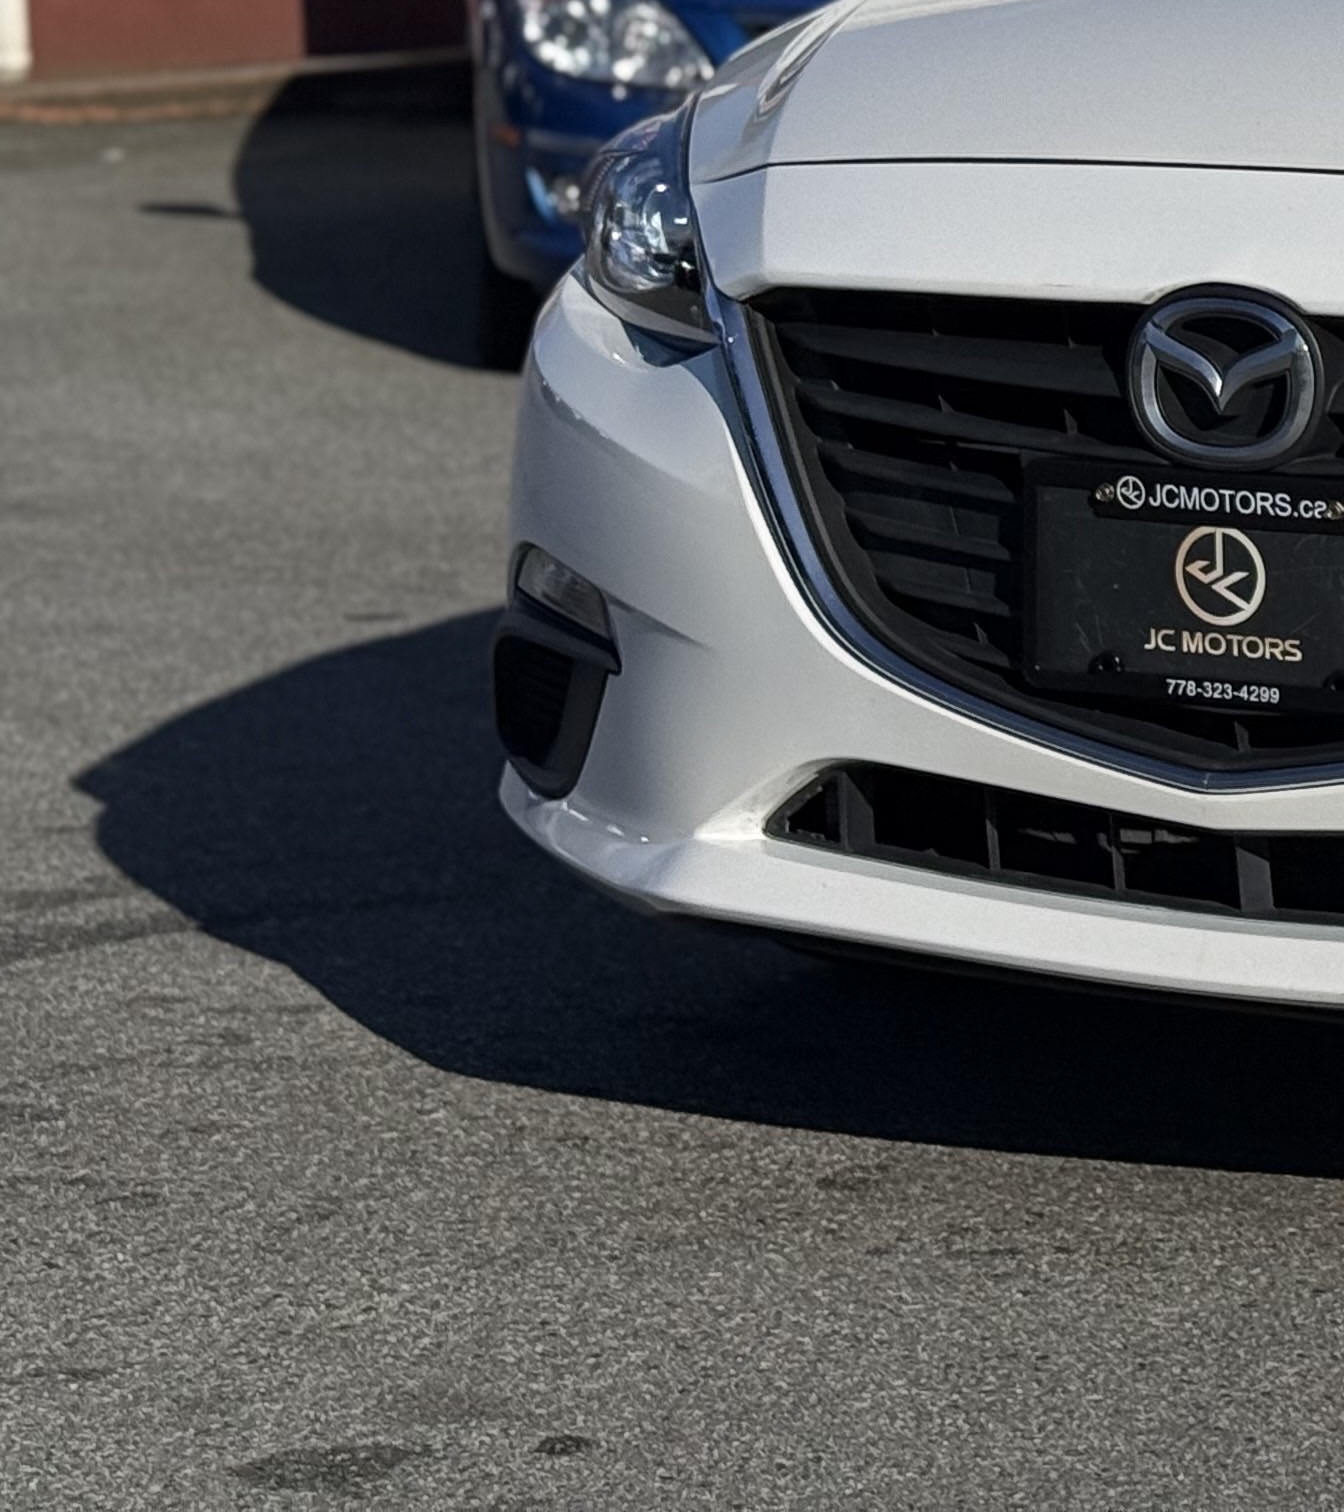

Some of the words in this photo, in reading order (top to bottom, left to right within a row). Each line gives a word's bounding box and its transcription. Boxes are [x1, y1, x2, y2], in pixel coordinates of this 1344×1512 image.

[1143, 628, 1176, 652] JC
[1182, 631, 1303, 662] MOTORS
[1165, 678, 1281, 704] 778-323-4299
